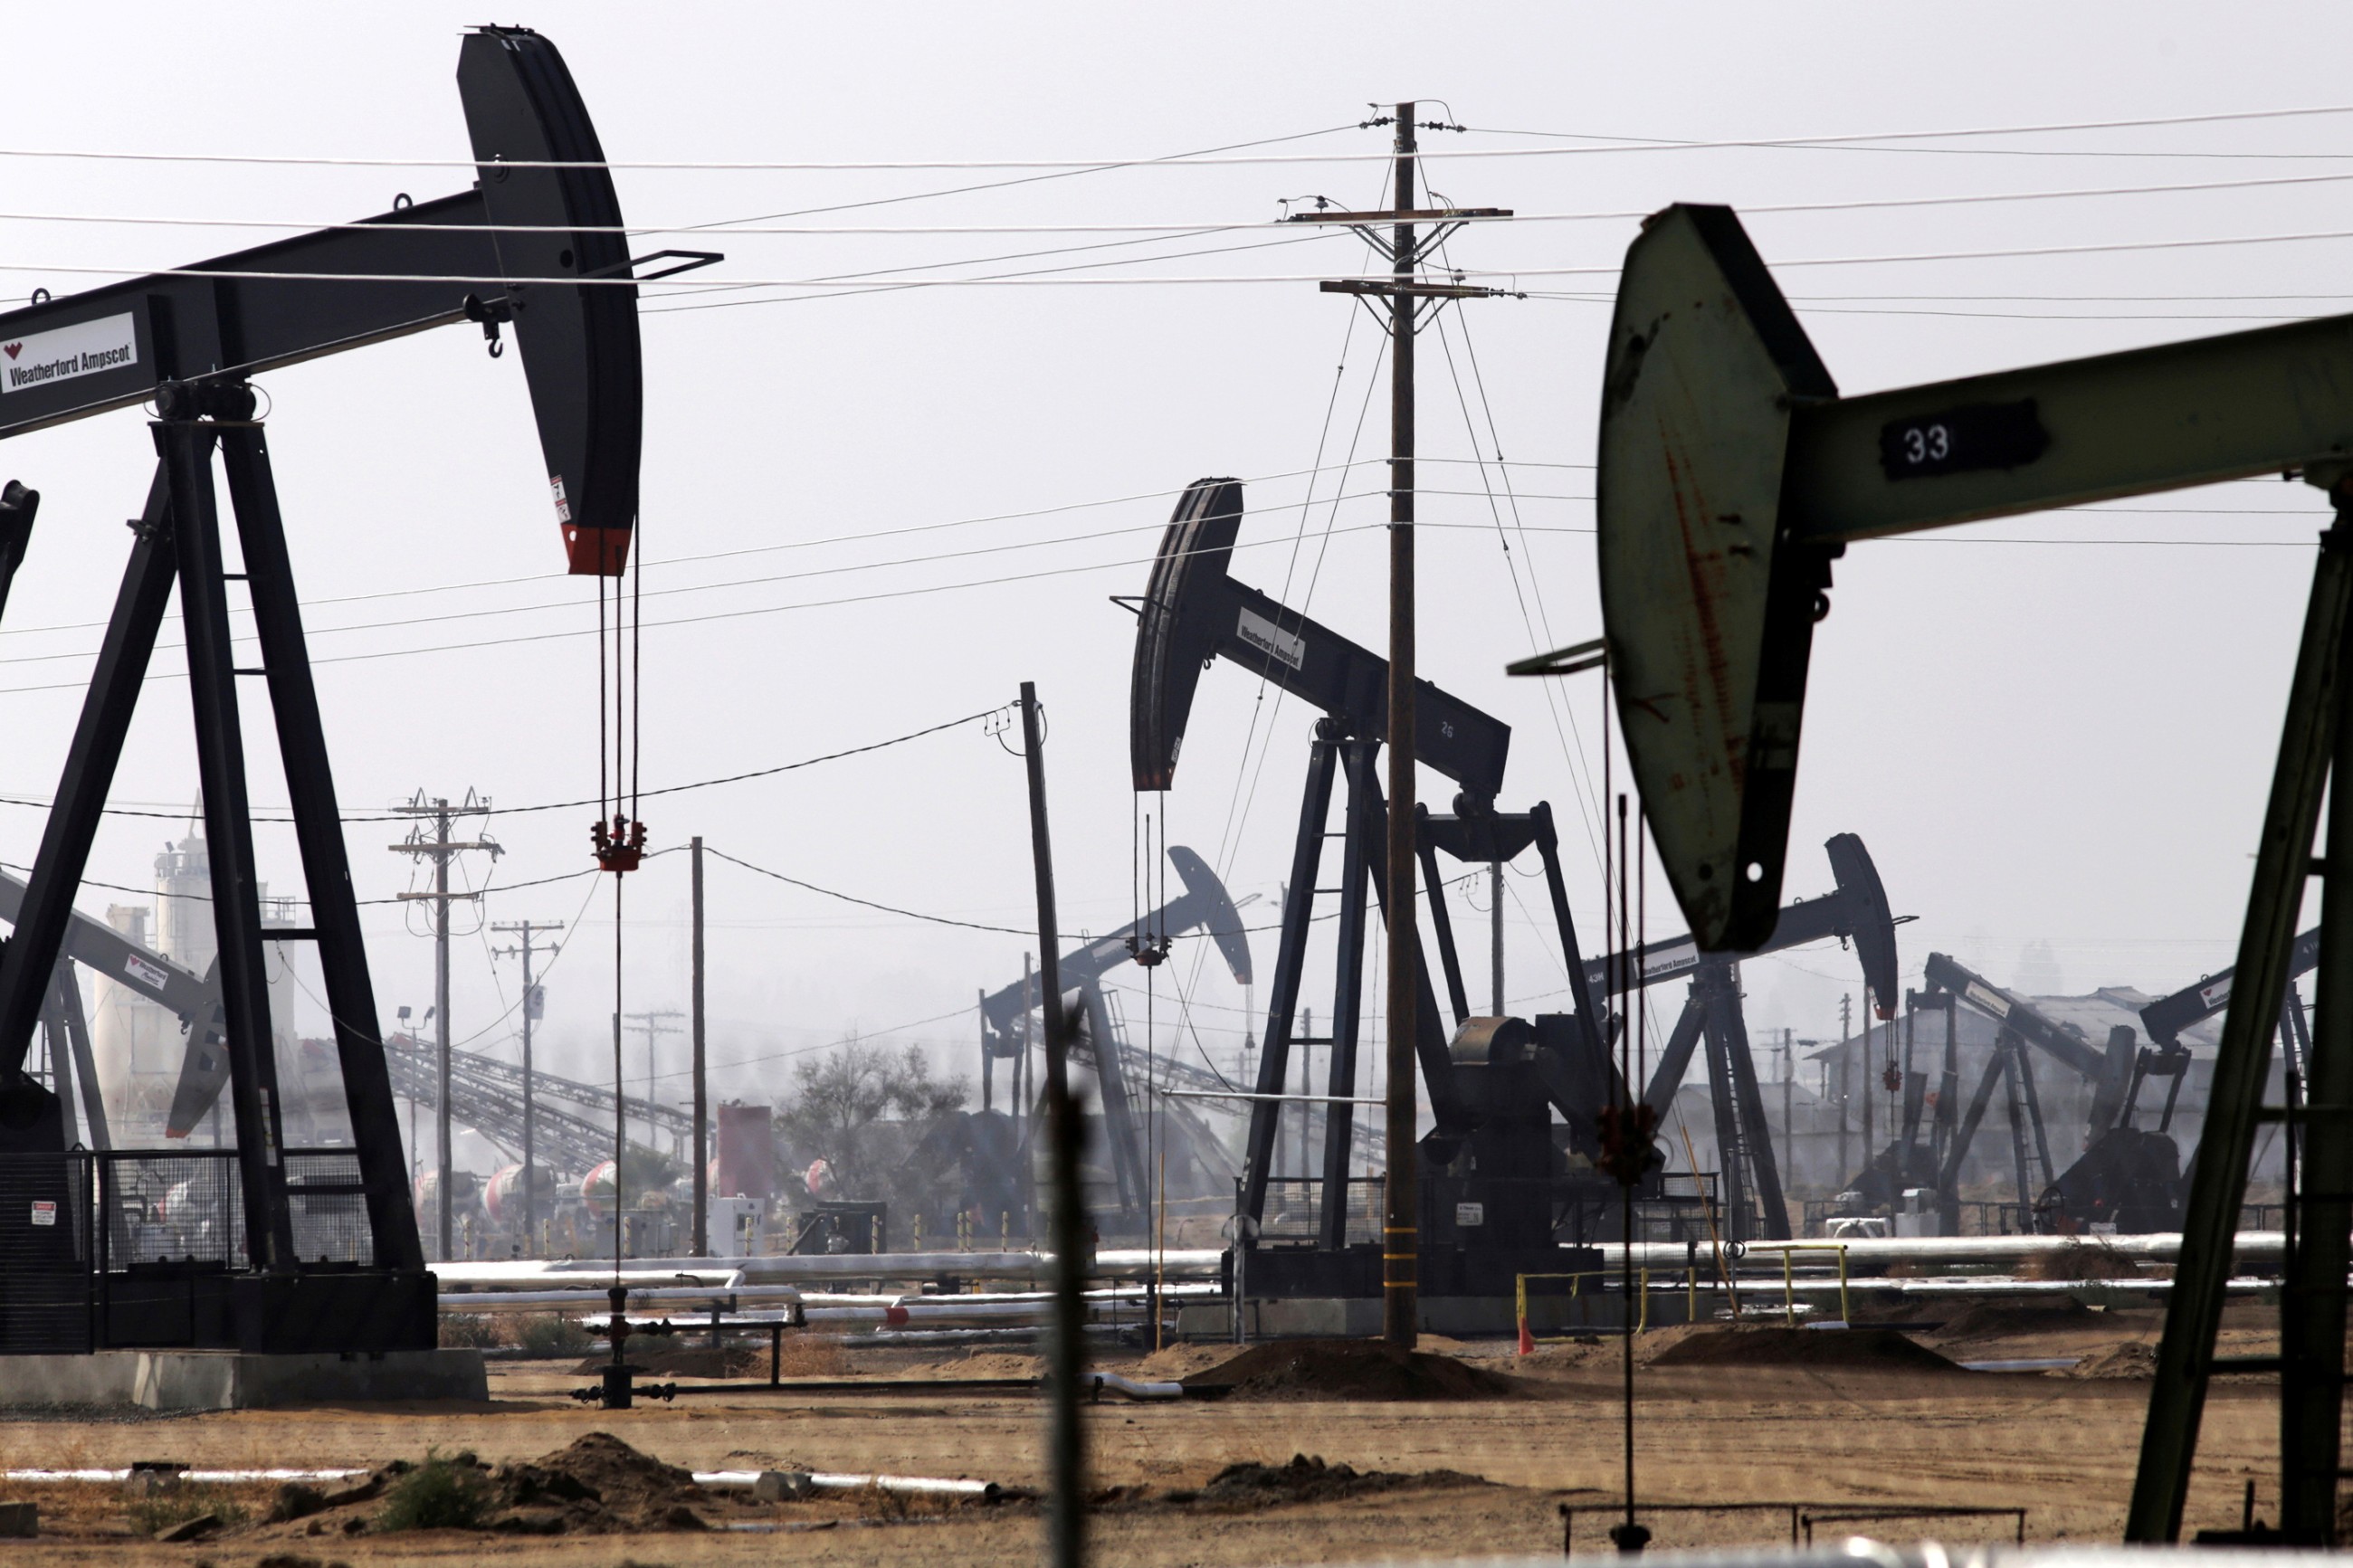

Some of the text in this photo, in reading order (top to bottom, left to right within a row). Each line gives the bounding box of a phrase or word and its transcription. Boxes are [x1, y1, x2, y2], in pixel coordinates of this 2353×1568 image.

[10, 344, 130, 387] Weatherford Ampscot
[1904, 423, 1948, 463] 33
[1441, 721, 1453, 738] 26
